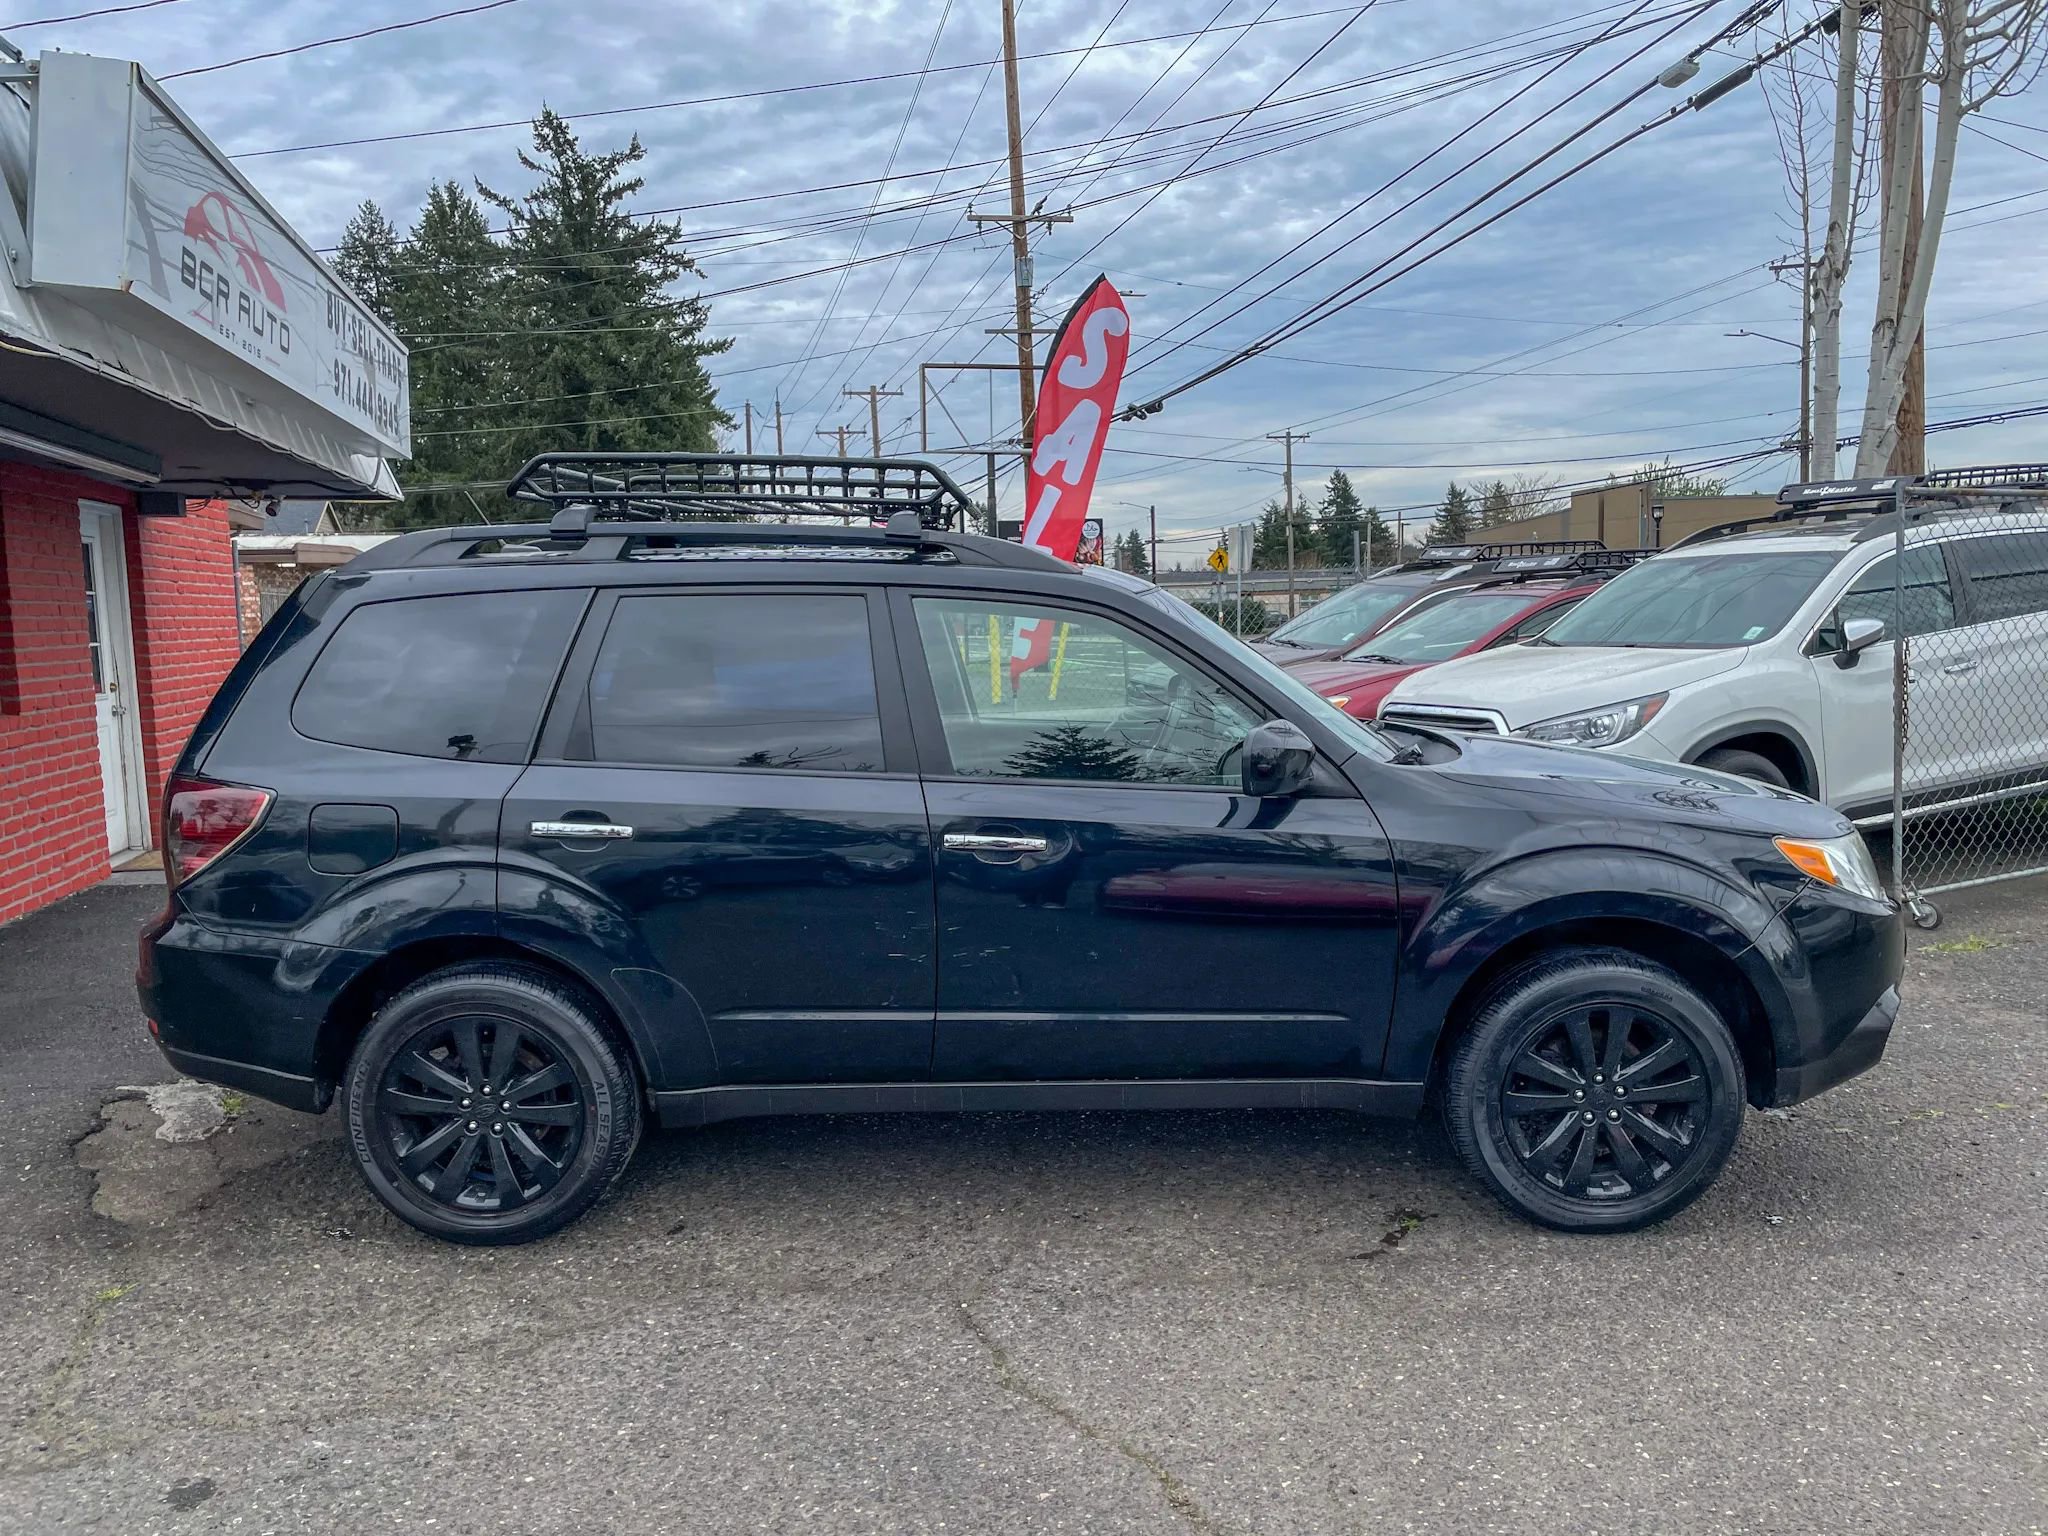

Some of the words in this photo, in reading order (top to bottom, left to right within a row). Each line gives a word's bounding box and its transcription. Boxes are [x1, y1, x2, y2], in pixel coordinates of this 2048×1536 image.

[219, 323, 239, 345] EST.
[238, 290, 290, 355] AUTO
[593, 1080, 609, 1109] ALL
